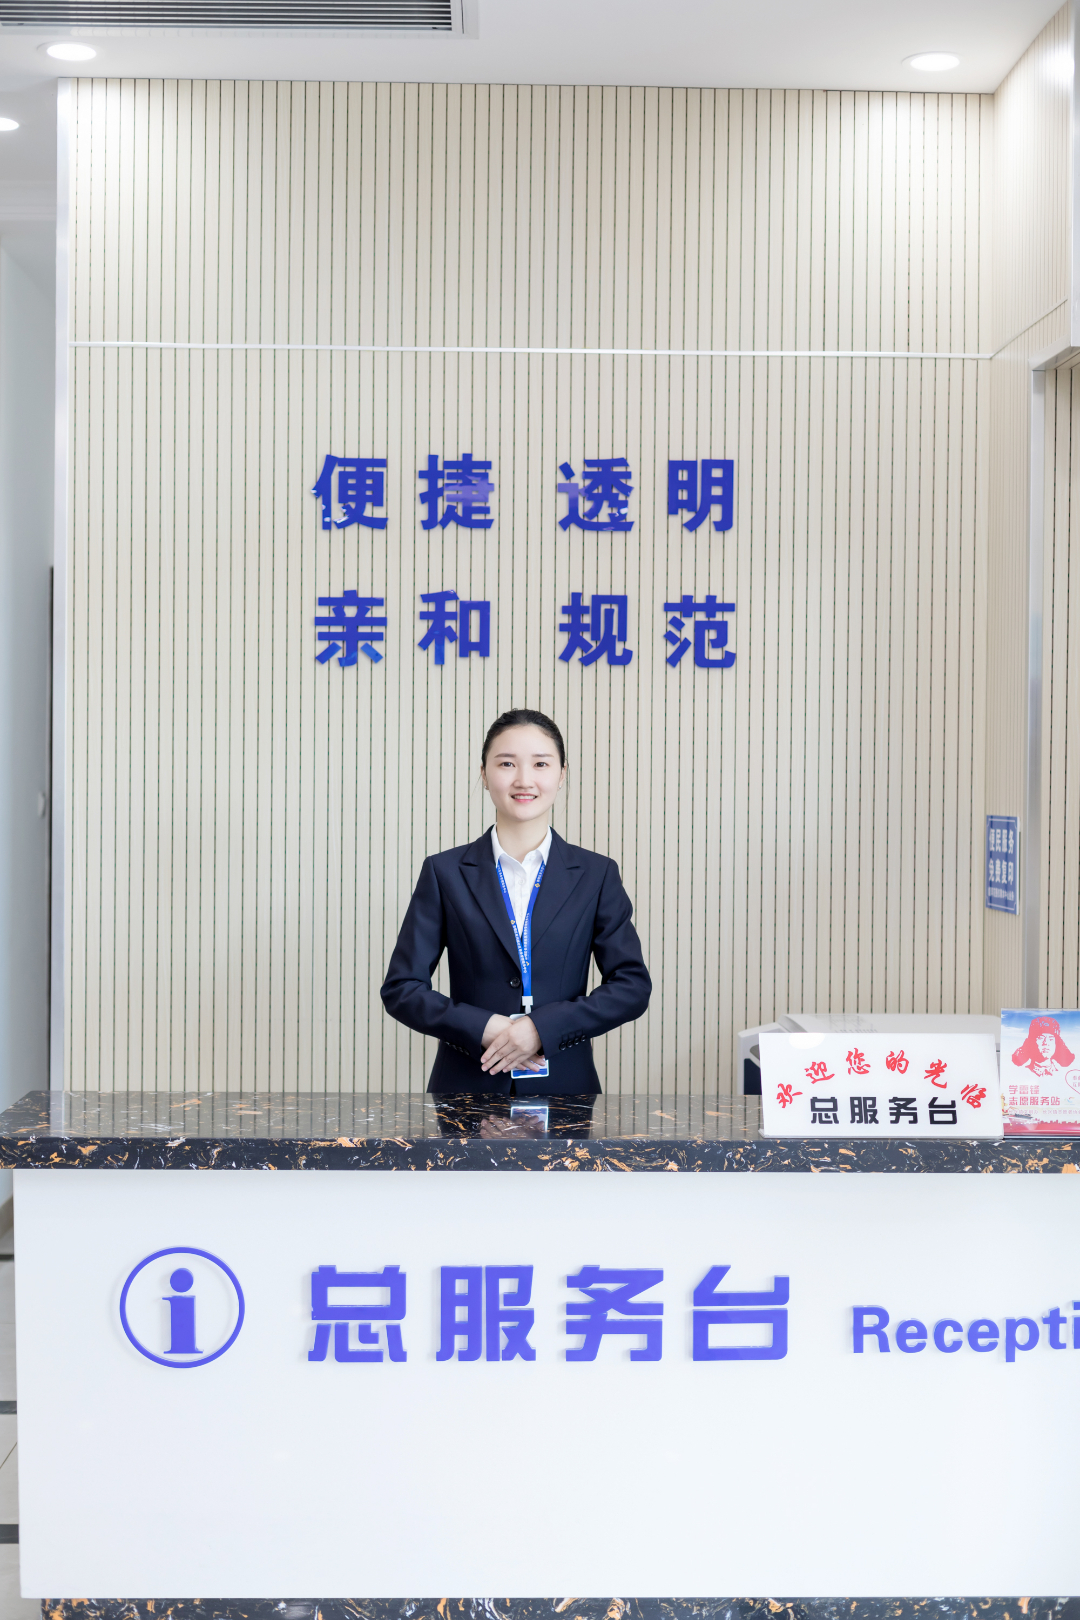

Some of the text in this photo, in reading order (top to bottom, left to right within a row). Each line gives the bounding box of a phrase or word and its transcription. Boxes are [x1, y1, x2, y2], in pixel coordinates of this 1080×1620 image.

[311, 453, 735, 533] 便捷 透明
[314, 589, 737, 669] 亲和 规范
[776, 1047, 987, 1109] 欢迎您的光临
[1009, 1084, 1040, 1095] 学雷锋
[1009, 1096, 1061, 1106] 志愿服务站
[810, 1096, 958, 1125] 总服务台
[308, 1265, 790, 1363] 总服务台
